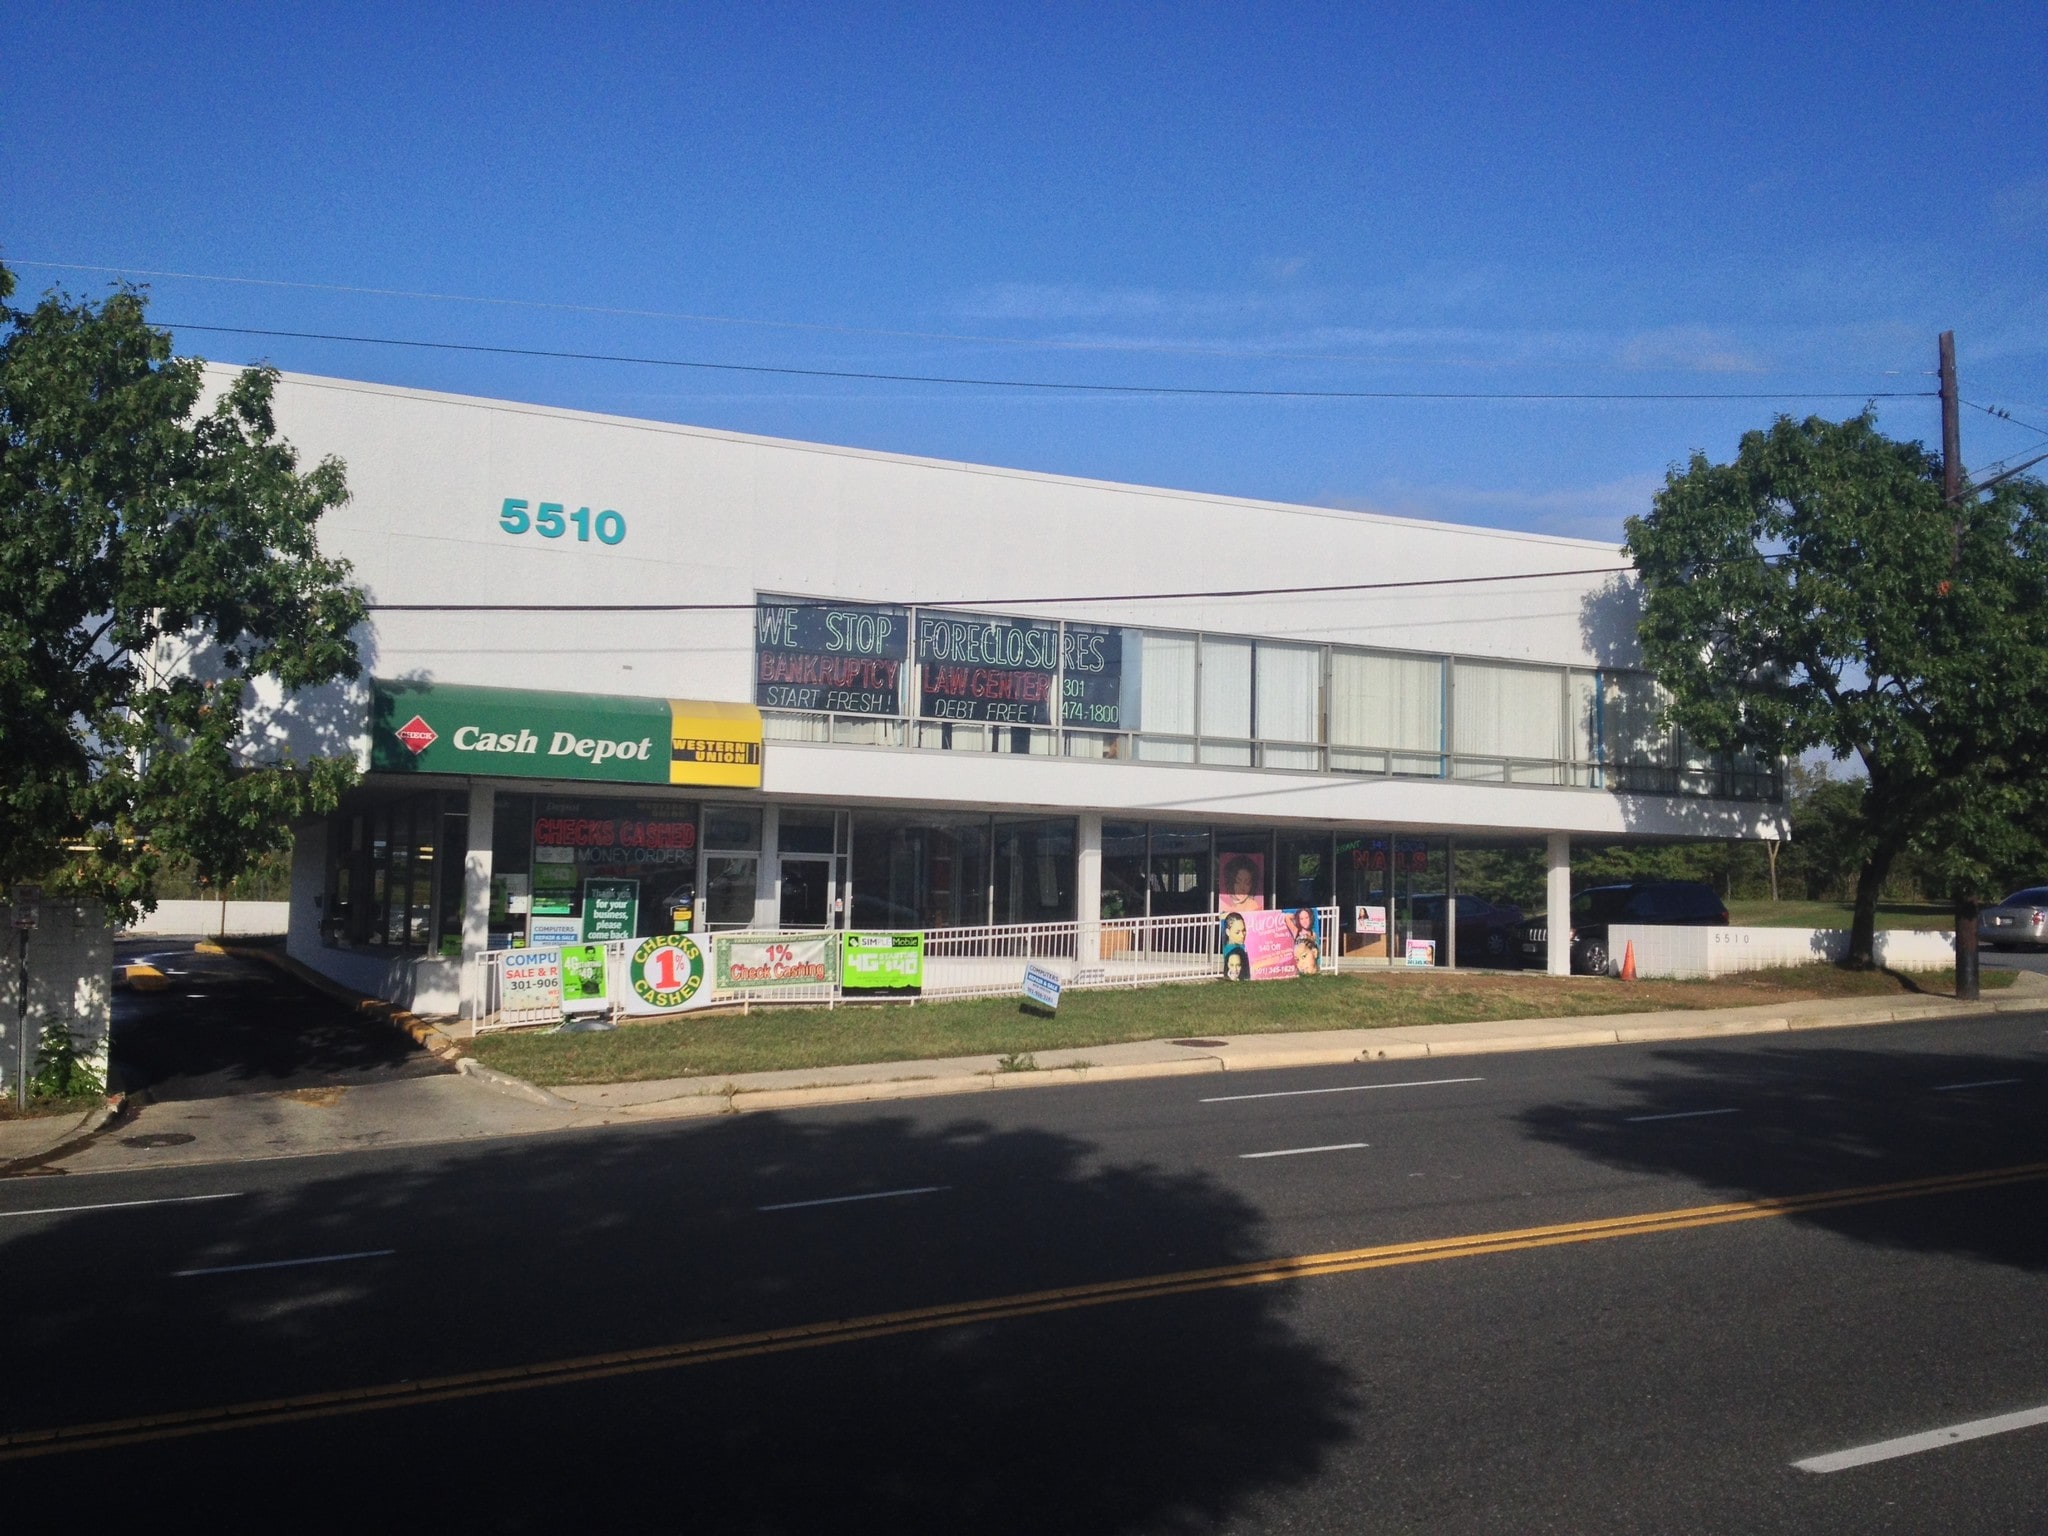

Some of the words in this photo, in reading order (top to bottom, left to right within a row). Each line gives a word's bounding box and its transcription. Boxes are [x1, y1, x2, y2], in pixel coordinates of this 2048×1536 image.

[499, 498, 626, 545] 5510
[757, 607, 799, 647] WE
[826, 611, 892, 654] STOP
[920, 620, 1105, 672] FORECLOSURES
[761, 651, 899, 690] BANKRUPTCY
[923, 664, 969, 696] LAW
[972, 668, 1049, 702] CENTER
[1063, 679, 1085, 697] 301
[767, 686, 820, 708] START
[935, 699, 977, 719] DEBT
[400, 731, 433, 740] CHECK
[453, 726, 538, 754] Cash
[548, 731, 652, 764] Depot
[673, 739, 745, 753] WESTERN
[695, 751, 745, 763] UNION
[536, 818, 614, 845] CHECKS
[620, 821, 696, 849] CASHED
[578, 846, 633, 863] MONEY
[634, 848, 694, 864] ORDERS
[1353, 849, 1427, 872] NALS
[596, 899, 608, 908] for
[609, 901, 629, 912] your
[593, 910, 629, 920] business,
[596, 921, 622, 931] please
[610, 931, 629, 939] back
[862, 938, 892, 946] SIMPLE
[892, 937, 917, 946] Mobile
[1715, 933, 1749, 944] 5510
[634, 935, 699, 963] CHECKS
[765, 944, 793, 961] 1%
[730, 963, 771, 980] Check
[774, 961, 825, 979] Cashing
[848, 953, 879, 972] 4G
[506, 969, 534, 979] SALE
[538, 968, 546, 976] &
[511, 978, 558, 990] 301-906
[634, 975, 700, 1006] CASHED
